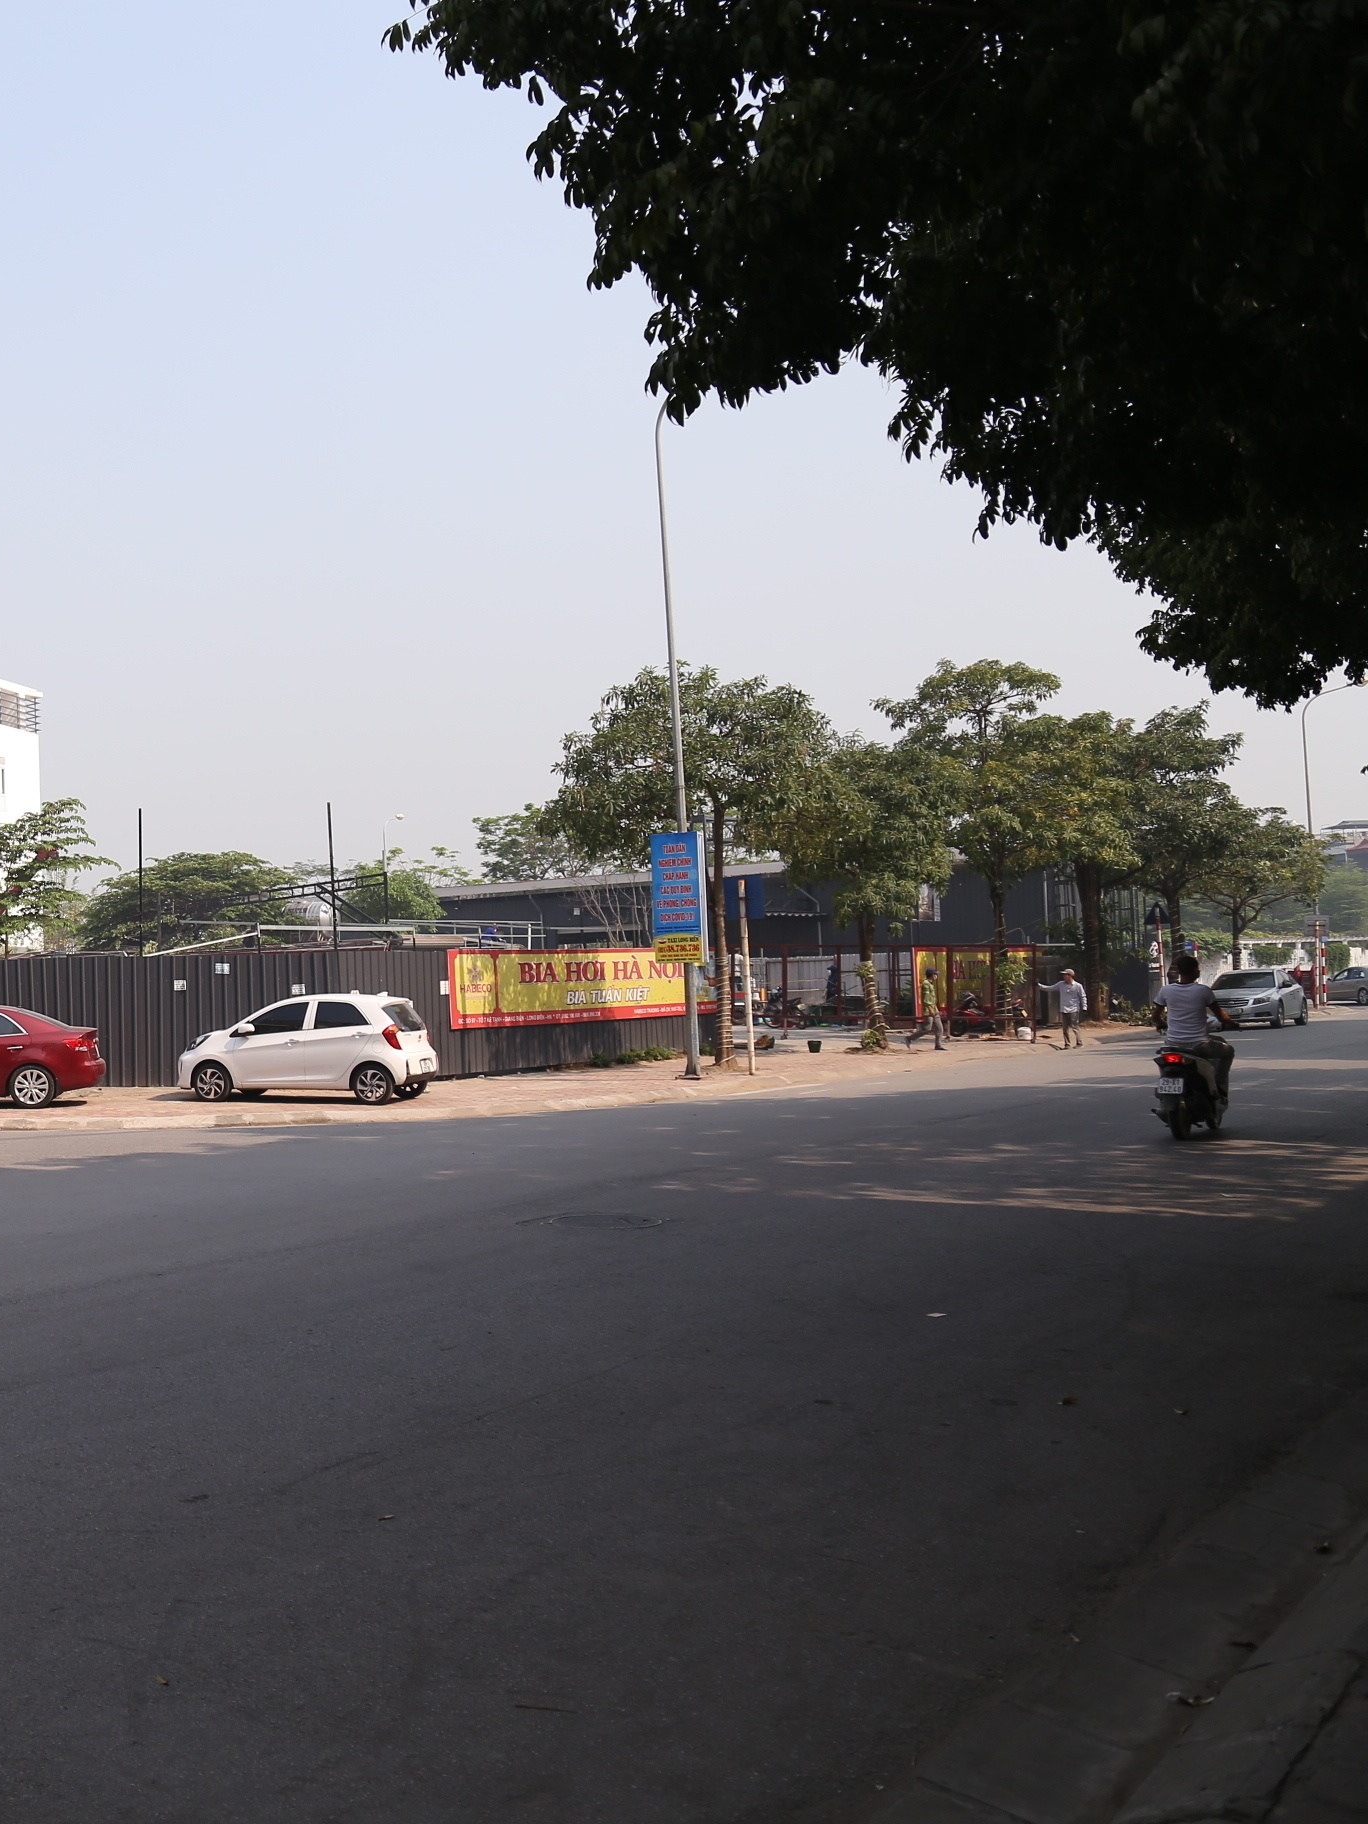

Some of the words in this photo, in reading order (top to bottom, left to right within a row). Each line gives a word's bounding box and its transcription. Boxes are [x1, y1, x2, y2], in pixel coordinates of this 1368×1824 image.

[518, 961, 561, 983] BIA
[563, 960, 607, 982] HƠI
[612, 954, 644, 981] HÀ
[459, 983, 492, 993] HABECO
[566, 989, 588, 1005] BIA
[589, 984, 623, 1004] TUẤN
[625, 984, 650, 1004] KIỆT
